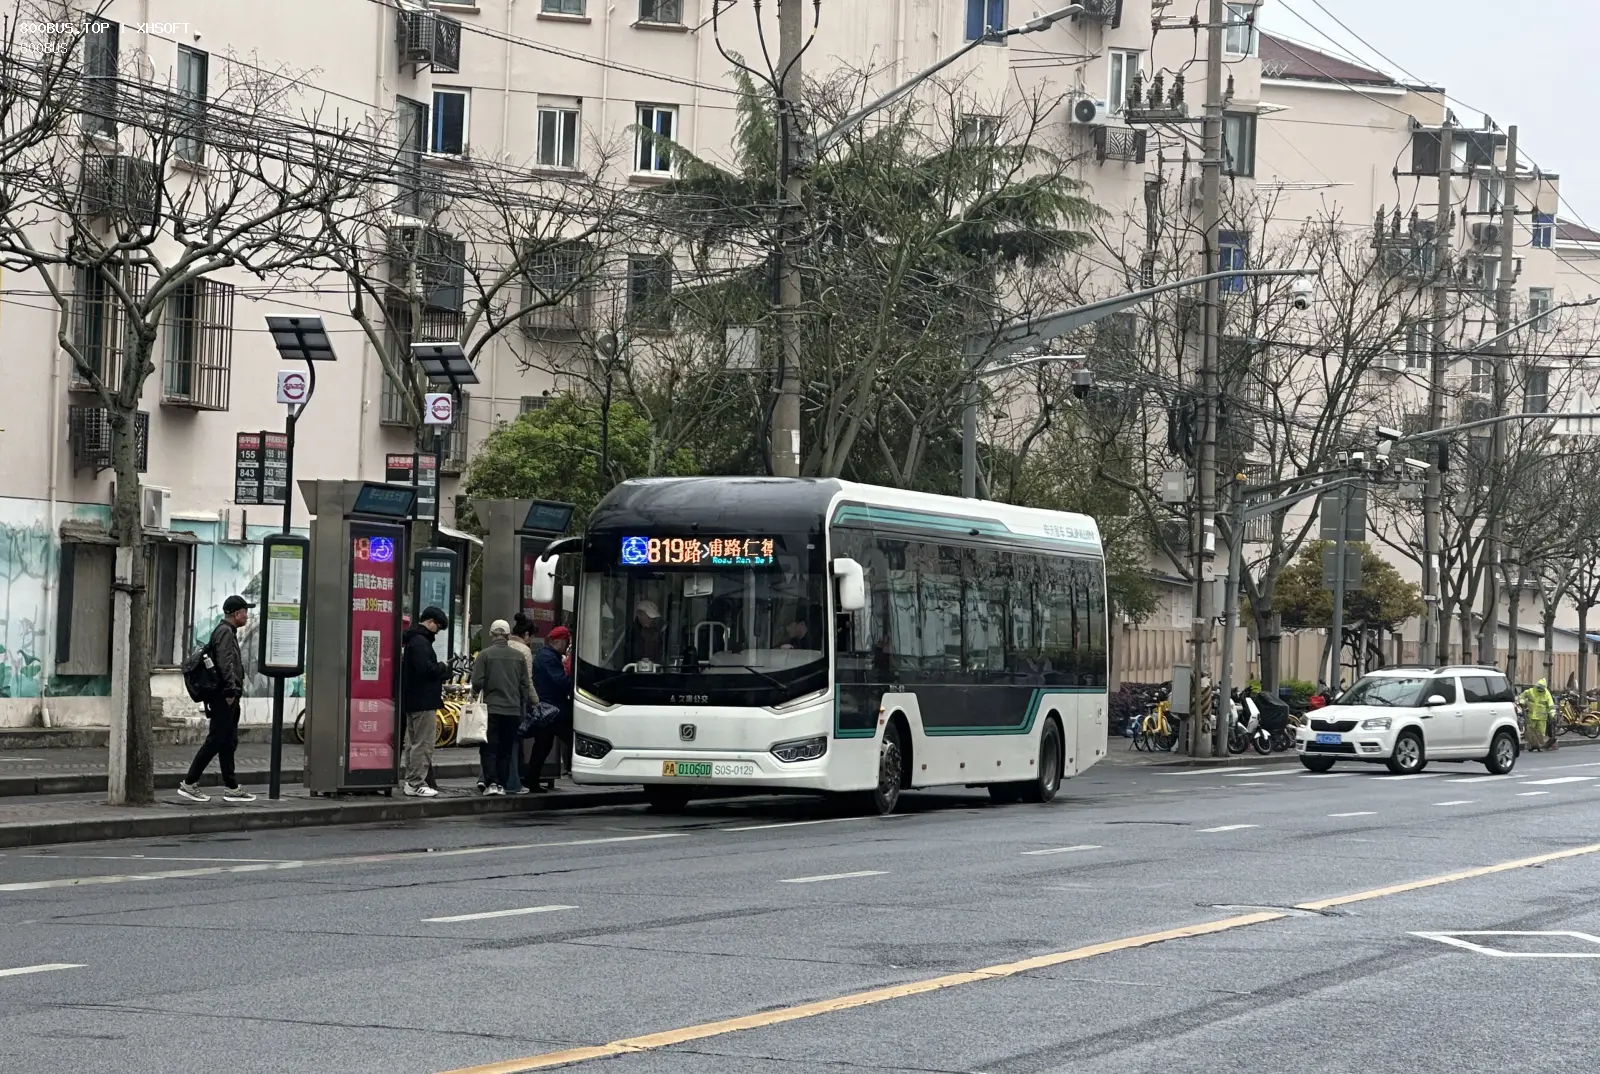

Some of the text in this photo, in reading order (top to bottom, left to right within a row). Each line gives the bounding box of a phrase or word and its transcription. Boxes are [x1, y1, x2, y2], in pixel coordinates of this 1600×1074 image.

[240, 450, 256, 459] 155
[239, 468, 255, 477] 843
[648, 538, 701, 563] 819路
[678, 763, 711, 775] 01060D
